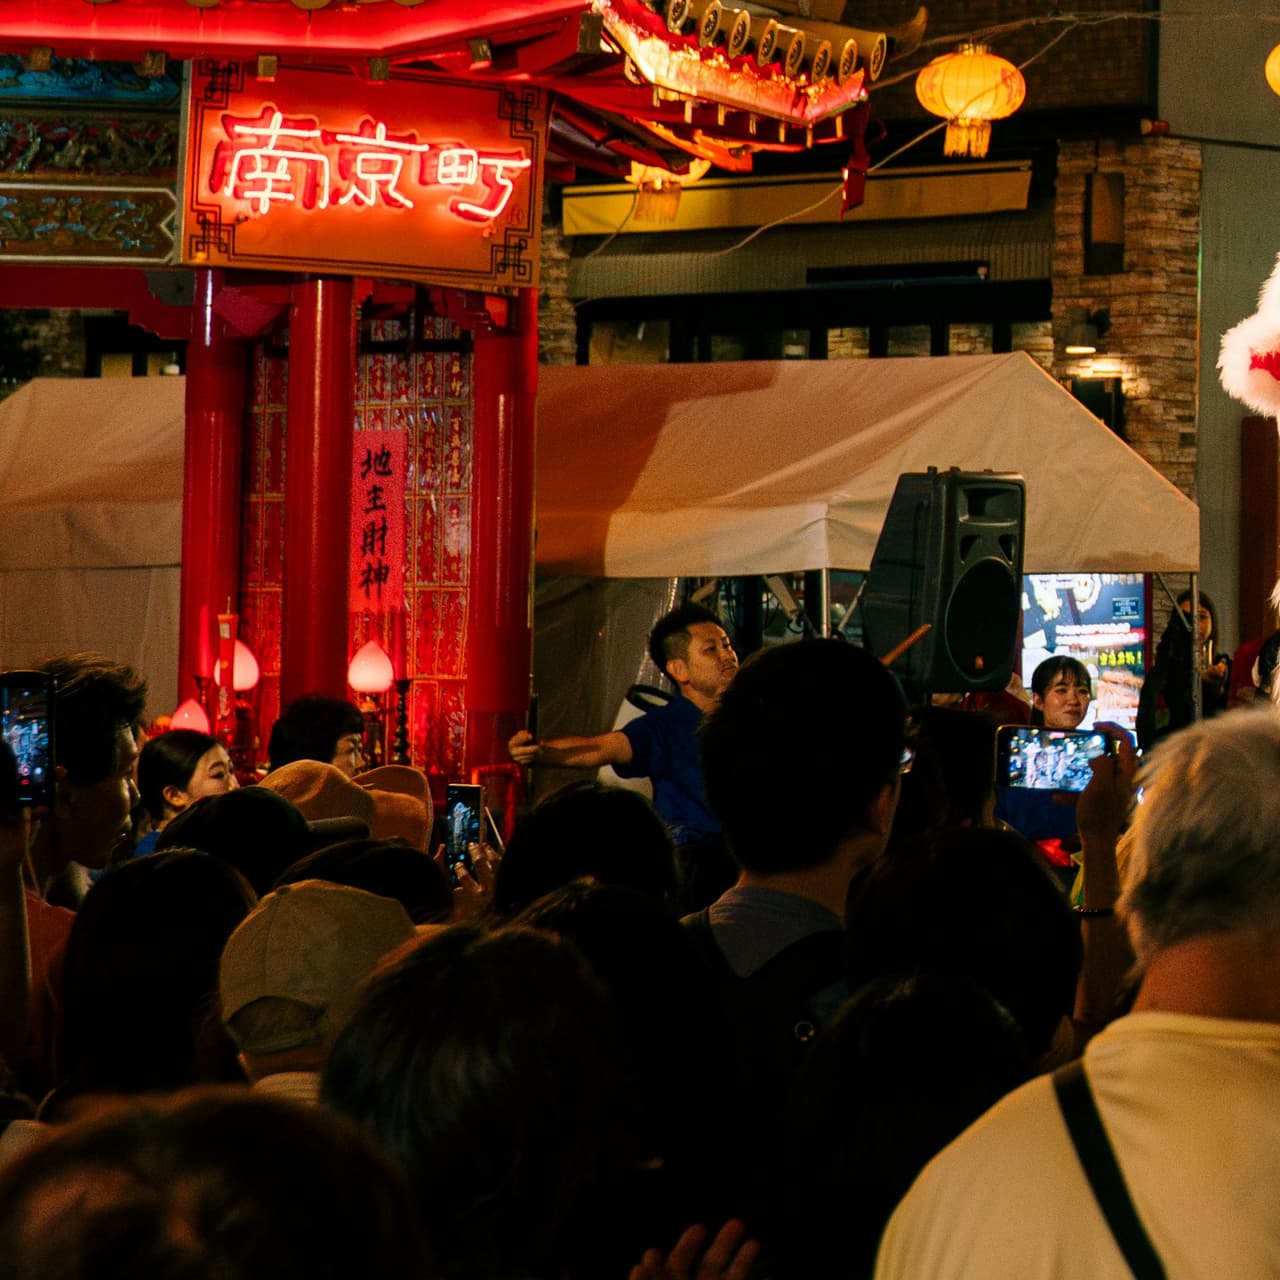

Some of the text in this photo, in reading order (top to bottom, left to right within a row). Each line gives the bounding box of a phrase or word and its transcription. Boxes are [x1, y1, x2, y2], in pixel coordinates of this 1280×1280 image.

[212, 106, 532, 222] 南京町
[360, 442, 394, 600] 地主財神
